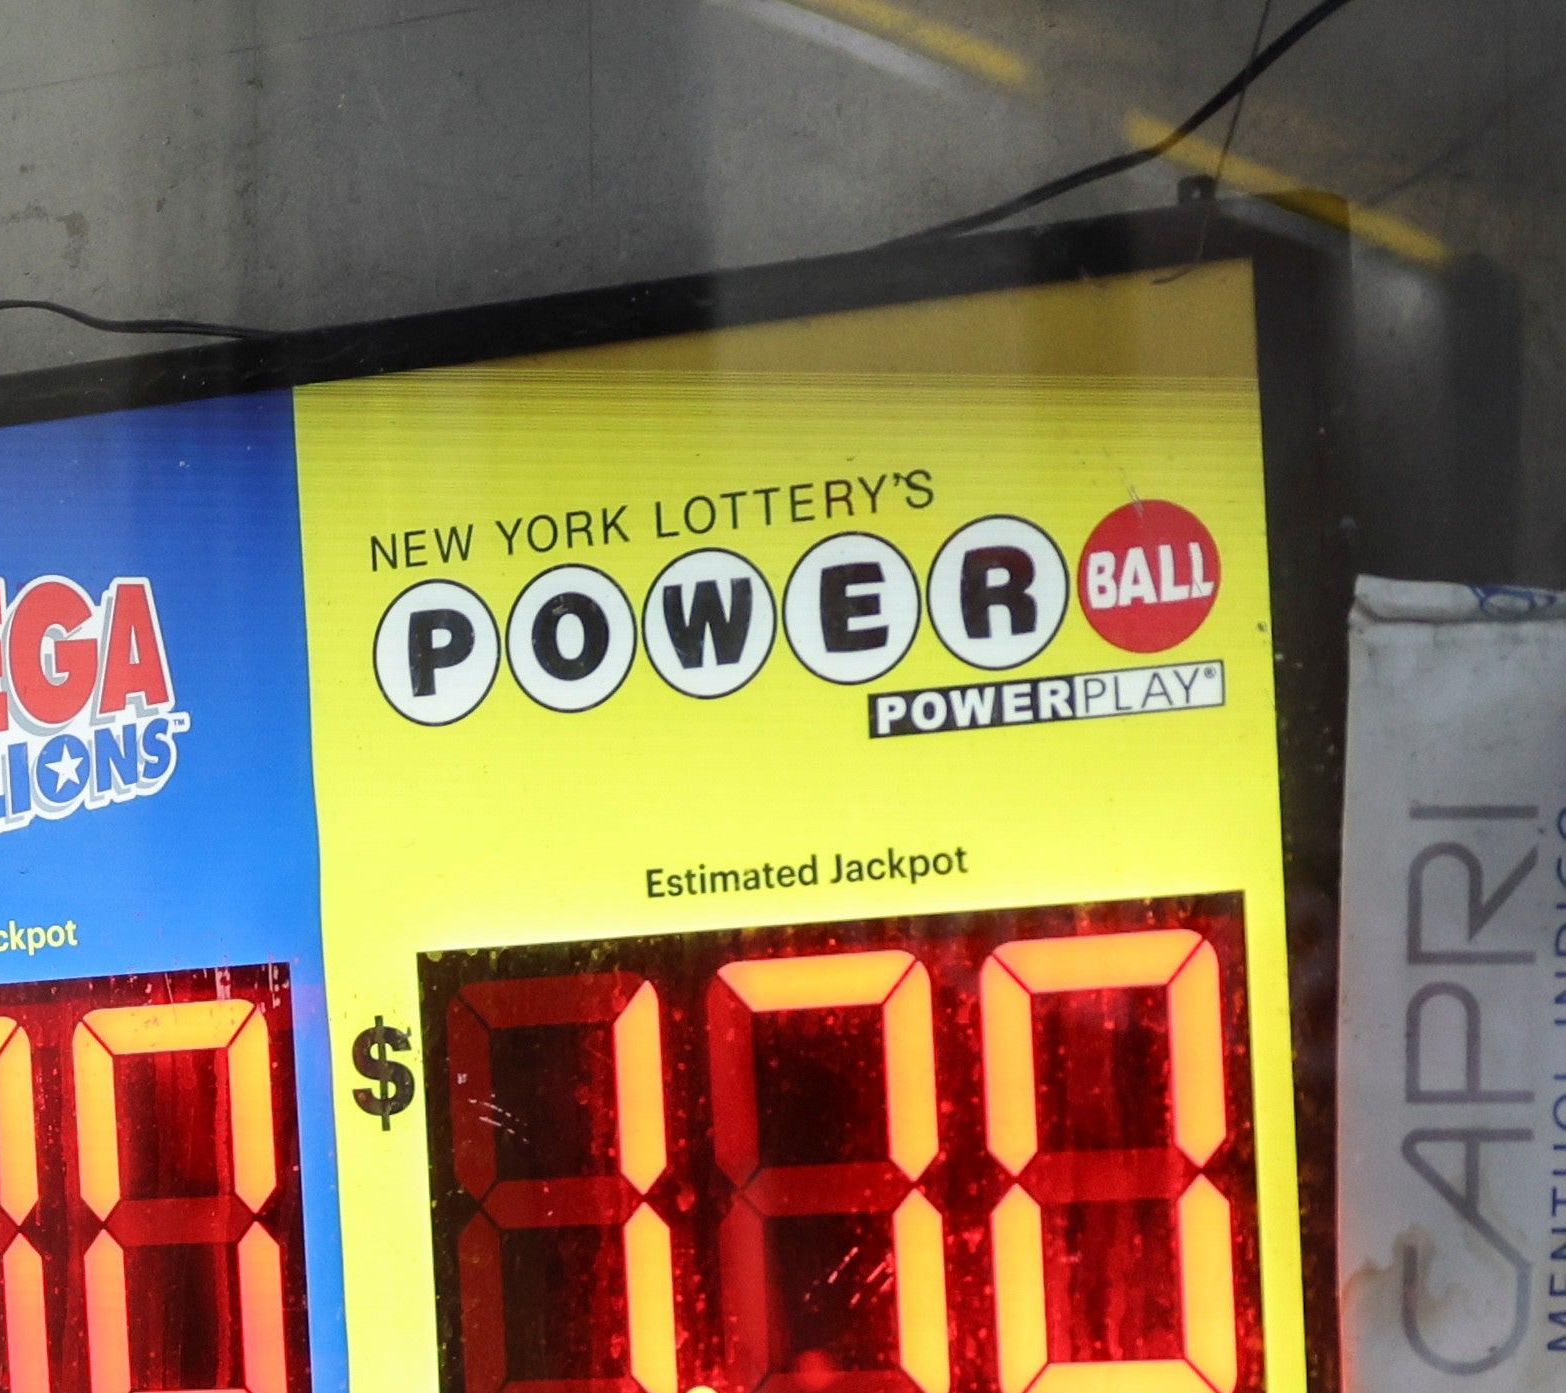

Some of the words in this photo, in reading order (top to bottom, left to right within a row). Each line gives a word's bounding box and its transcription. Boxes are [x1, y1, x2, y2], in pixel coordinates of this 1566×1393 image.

[370, 523, 476, 570] NEW
[495, 504, 630, 557] YORK
[655, 468, 937, 540] LOTTERY'S
[645, 855, 820, 899] Estimated
[829, 845, 970, 890] Jackpot
[1401, 805, 1540, 1376] CAPRI
